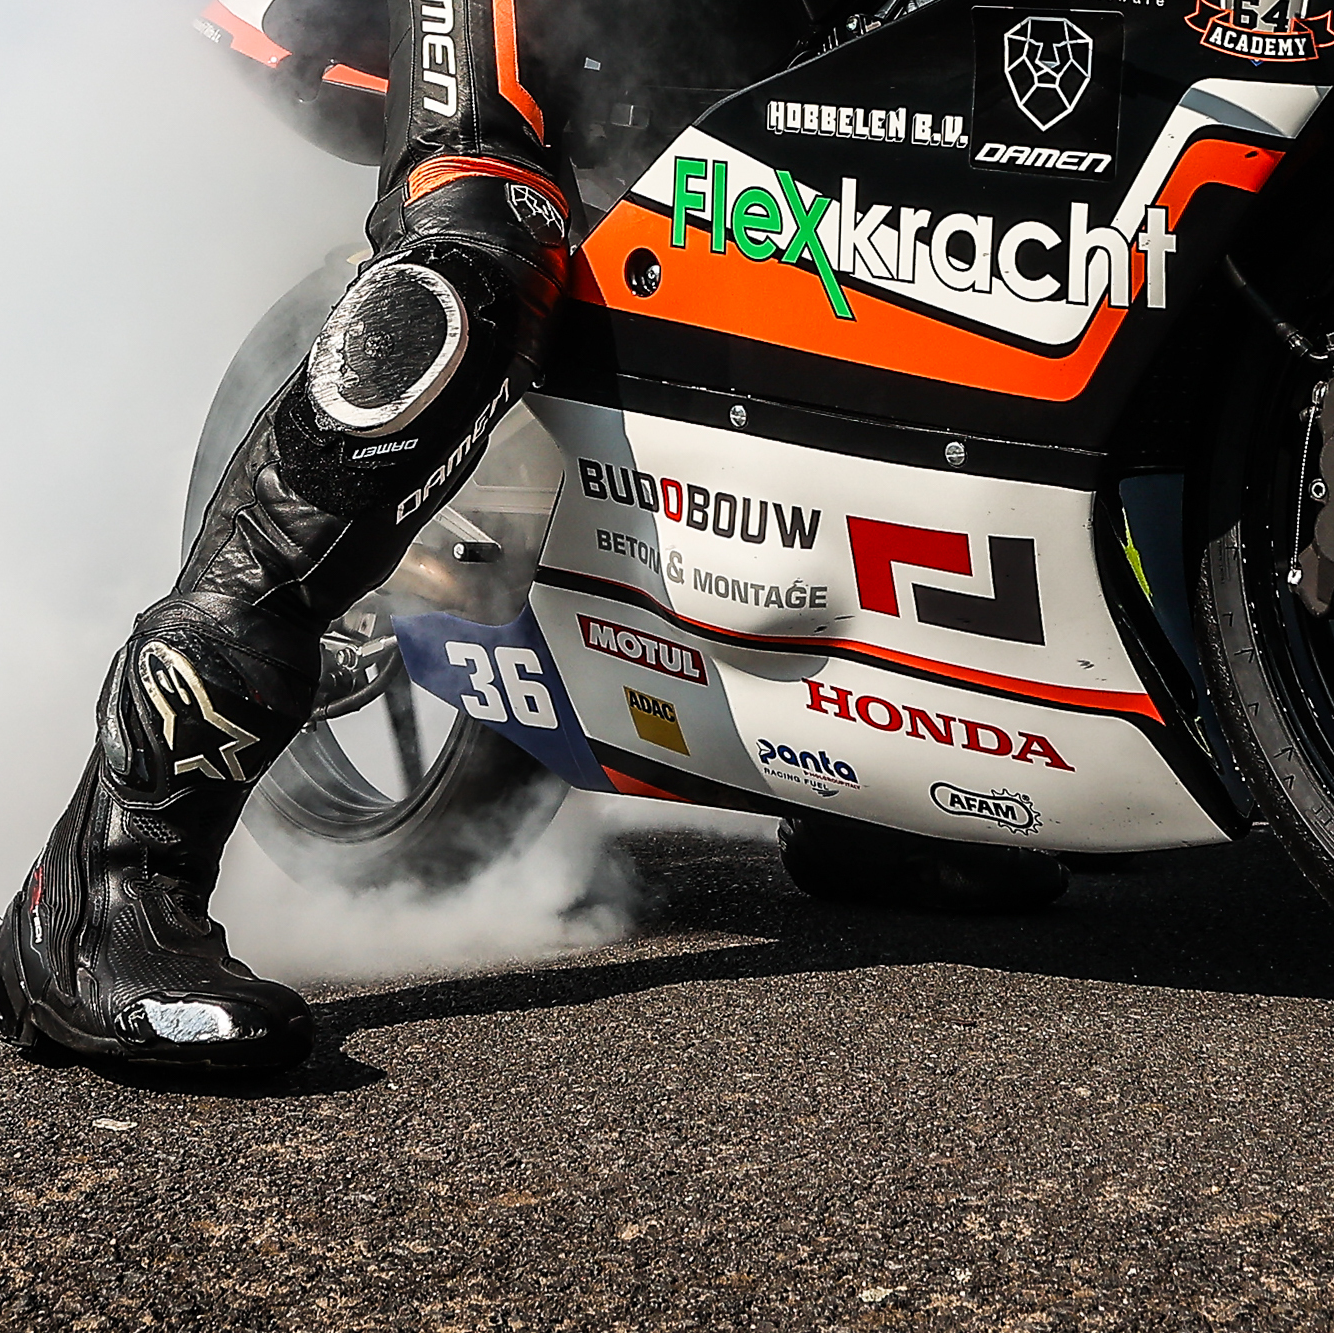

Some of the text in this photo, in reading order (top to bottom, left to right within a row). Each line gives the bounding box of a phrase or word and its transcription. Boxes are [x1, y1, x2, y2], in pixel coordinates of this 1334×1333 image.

[1209, 26, 1307, 56] ACADEMY
[767, 100, 969, 149] HOBBELEN B.V.
[974, 141, 1112, 174] DAMEN
[351, 438, 419, 460] DAMEN
[395, 377, 510, 525] DAMEN
[577, 457, 822, 550] BUDOBOUW
[597, 528, 829, 610] BETON & MONTAGE
[588, 621, 703, 678] MOTUL
[444, 640, 559, 730] 36
[627, 689, 678, 724] ADAC
[801, 676, 1077, 772] HONDA
[763, 767, 829, 791] RACING FUEL
[947, 792, 1018, 822] AFAM
